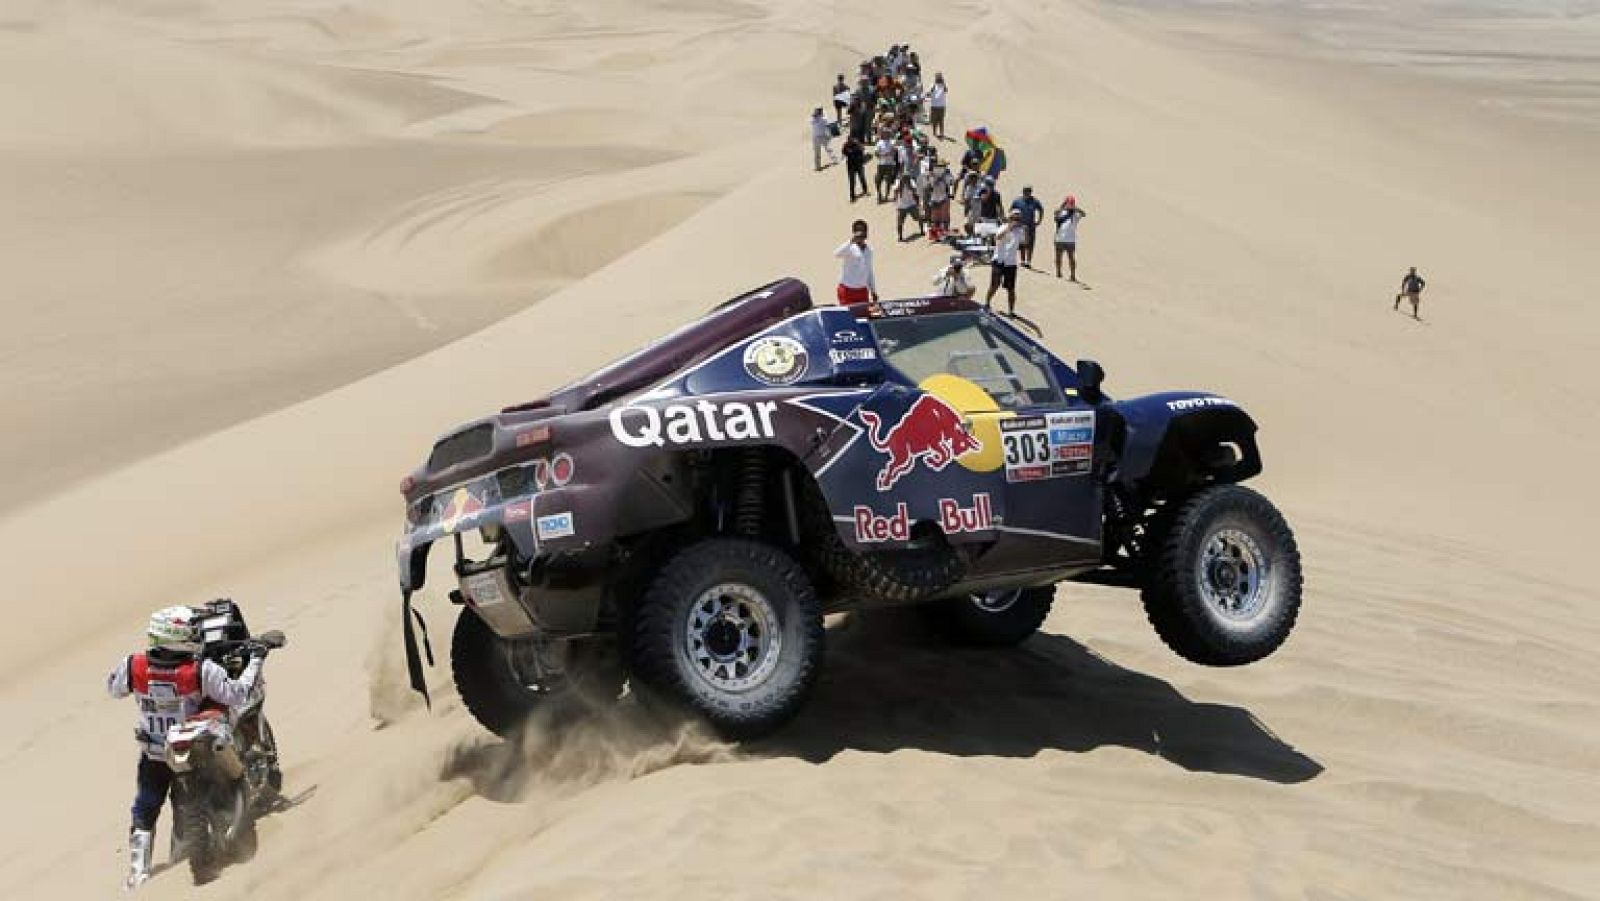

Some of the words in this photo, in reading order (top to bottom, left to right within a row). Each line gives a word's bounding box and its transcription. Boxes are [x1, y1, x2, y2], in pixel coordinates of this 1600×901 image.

[609, 400, 778, 447] Qatar
[1004, 432, 1050, 464] 303
[853, 502, 910, 543] Red
[939, 492, 993, 535] Bull
